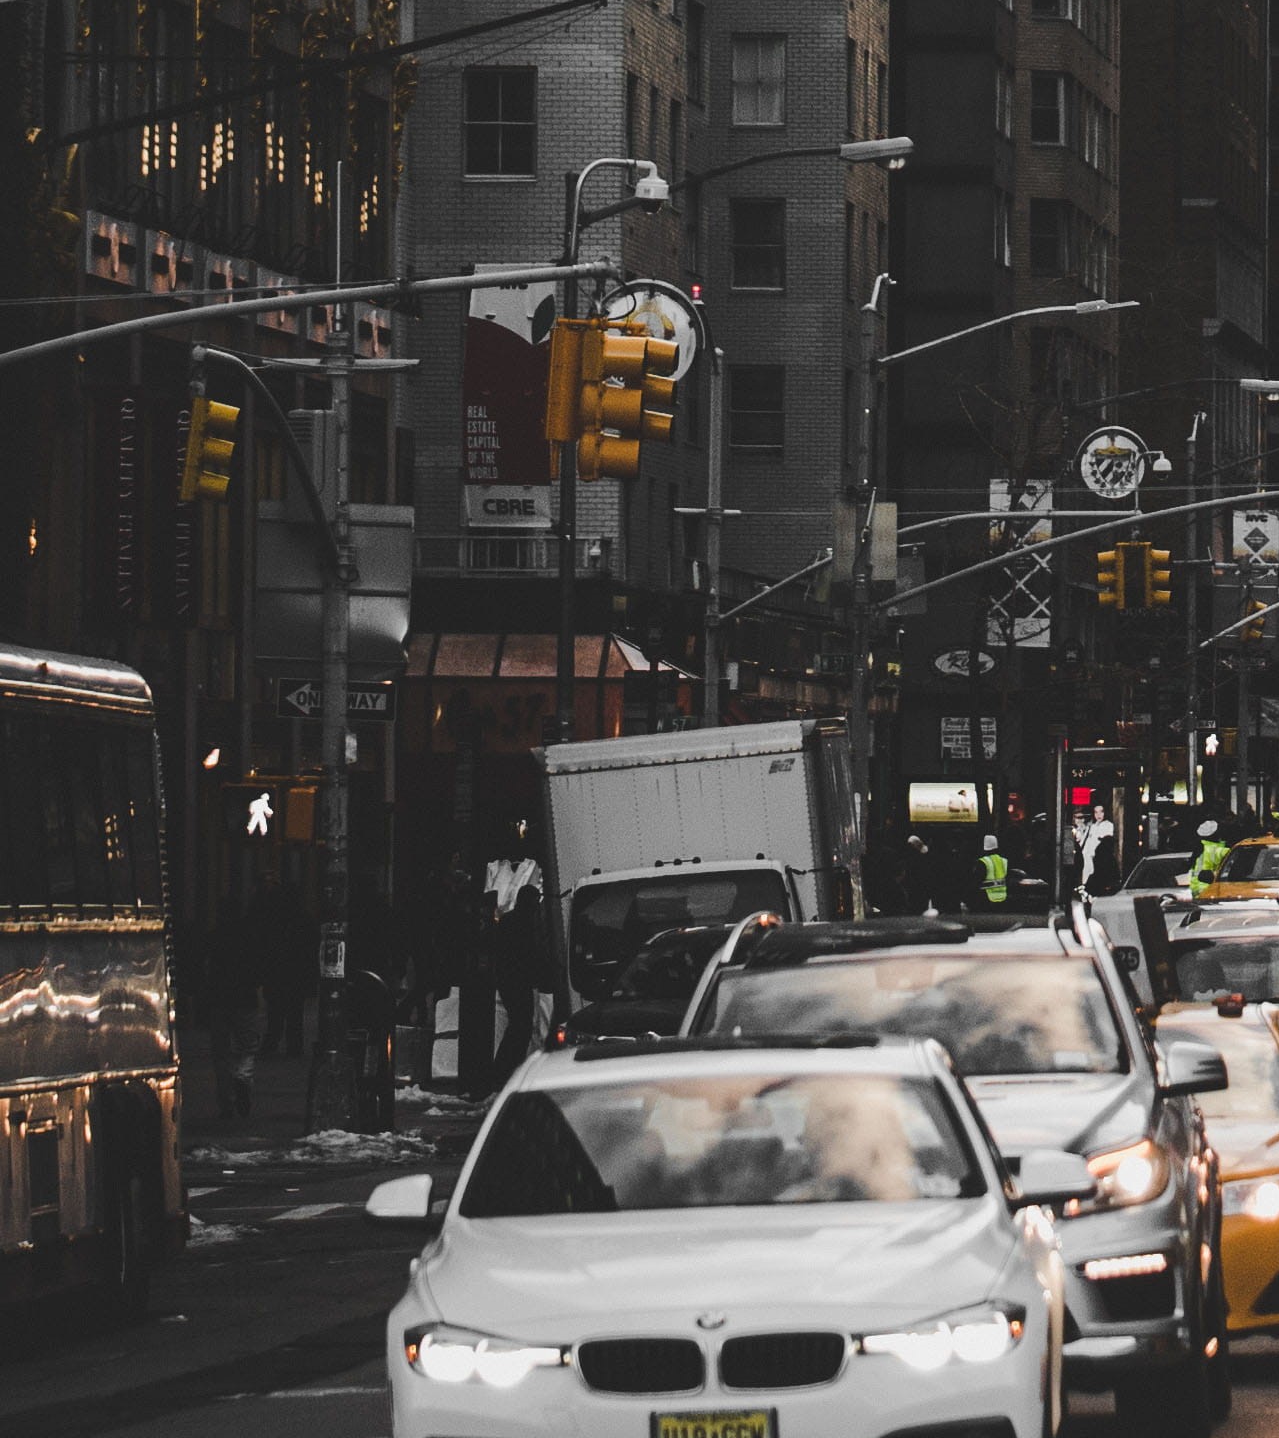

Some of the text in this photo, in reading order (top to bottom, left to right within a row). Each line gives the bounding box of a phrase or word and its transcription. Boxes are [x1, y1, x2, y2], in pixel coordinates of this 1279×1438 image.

[469, 405, 489, 419] REAL
[469, 420, 498, 434] ESTATE
[469, 435, 502, 450] CAPITAL
[469, 466, 501, 480] WORLD
[483, 497, 536, 517] CBRE
[1245, 514, 1269, 523] NYC
[296, 691, 320, 707] ON
